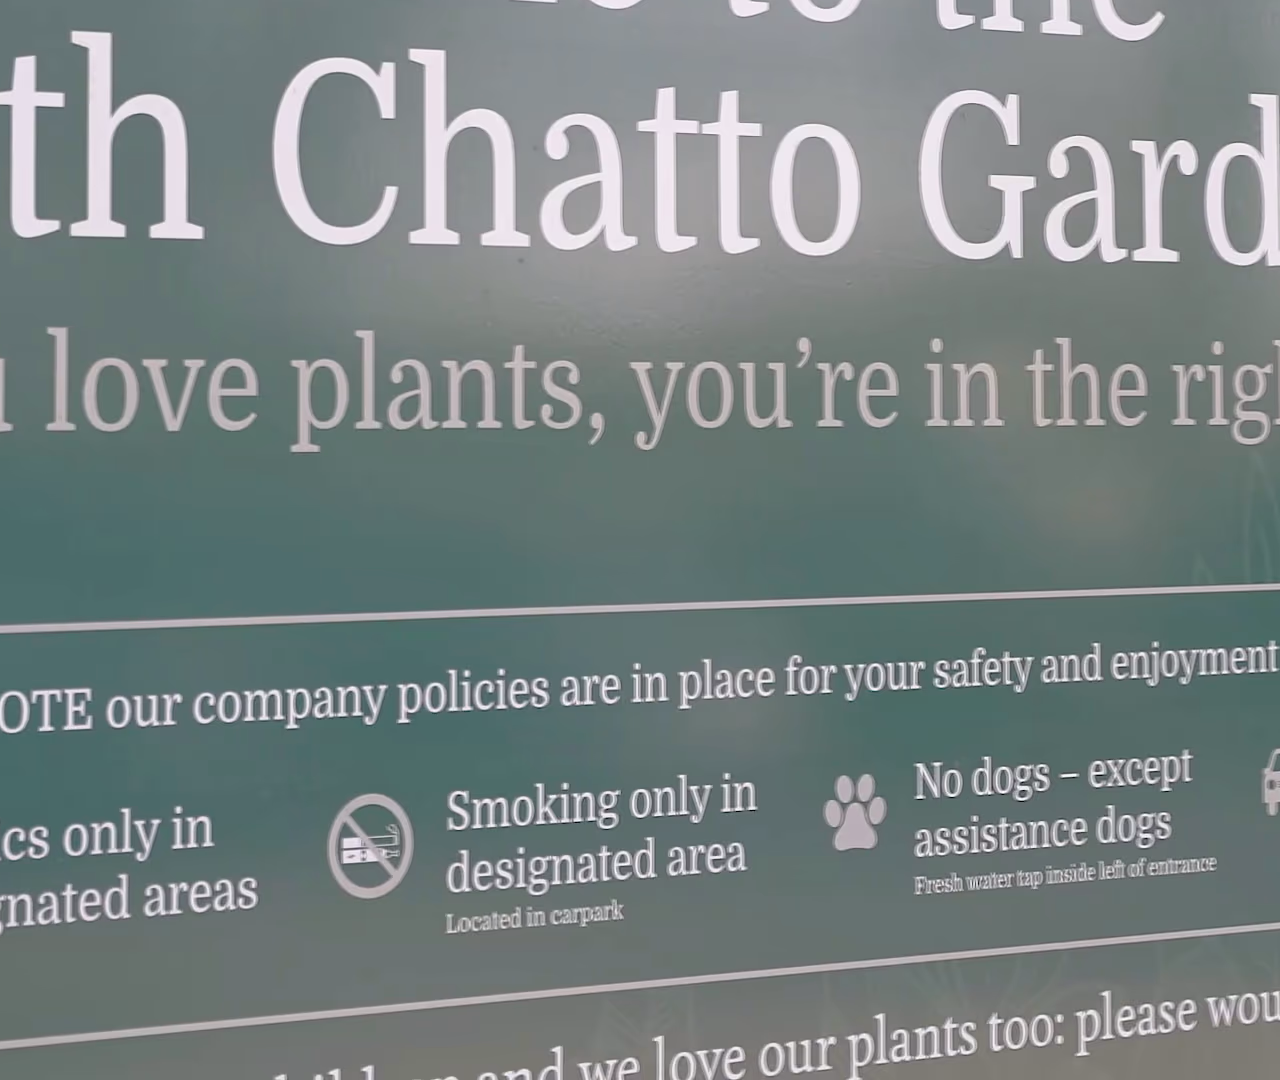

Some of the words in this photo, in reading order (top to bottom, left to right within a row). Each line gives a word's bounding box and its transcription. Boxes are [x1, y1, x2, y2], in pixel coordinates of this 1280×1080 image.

[274, 49, 860, 256] Chatto
[46, 327, 258, 431] love
[291, 330, 604, 452] plants,
[629, 337, 899, 450] you’re
[925, 338, 1005, 426] in
[1024, 338, 1147, 427] the
[107, 694, 183, 728] our
[193, 685, 388, 729] company
[397, 669, 549, 723] policies
[560, 675, 621, 706] are
[631, 663, 669, 702] in
[678, 659, 775, 709] place
[784, 655, 837, 695] for
[843, 661, 926, 701] your
[933, 647, 1034, 692] safety
[1041, 643, 1103, 683] and
[1110, 641, 1280, 686] enjoyment
[447, 783, 621, 830] Smoking
[630, 775, 713, 823] only
[721, 773, 758, 812] in
[914, 762, 963, 799] No
[971, 756, 1050, 801] dogs
[1088, 750, 1193, 791] except
[63, 808, 161, 861] only
[172, 806, 215, 849] in
[914, 816, 1088, 857] assistance
[1096, 805, 1172, 848] dogs
[446, 837, 657, 895] designated
[667, 843, 747, 876] area
[913, 872, 964, 895] Fresh
[966, 871, 1014, 890] water
[1017, 870, 1043, 890] tap
[1045, 862, 1096, 884] inside
[1099, 859, 1125, 880] left
[1127, 858, 1146, 878] of
[1147, 857, 1217, 876] entrance
[144, 877, 258, 916] areas
[445, 907, 521, 934] Located
[526, 907, 546, 927] in
[550, 899, 625, 927] carpark
[652, 1036, 745, 1080] love
[759, 1037, 837, 1076] our
[846, 1013, 977, 1080] plants
[987, 1013, 1064, 1051] too:
[1075, 991, 1197, 1056] please
